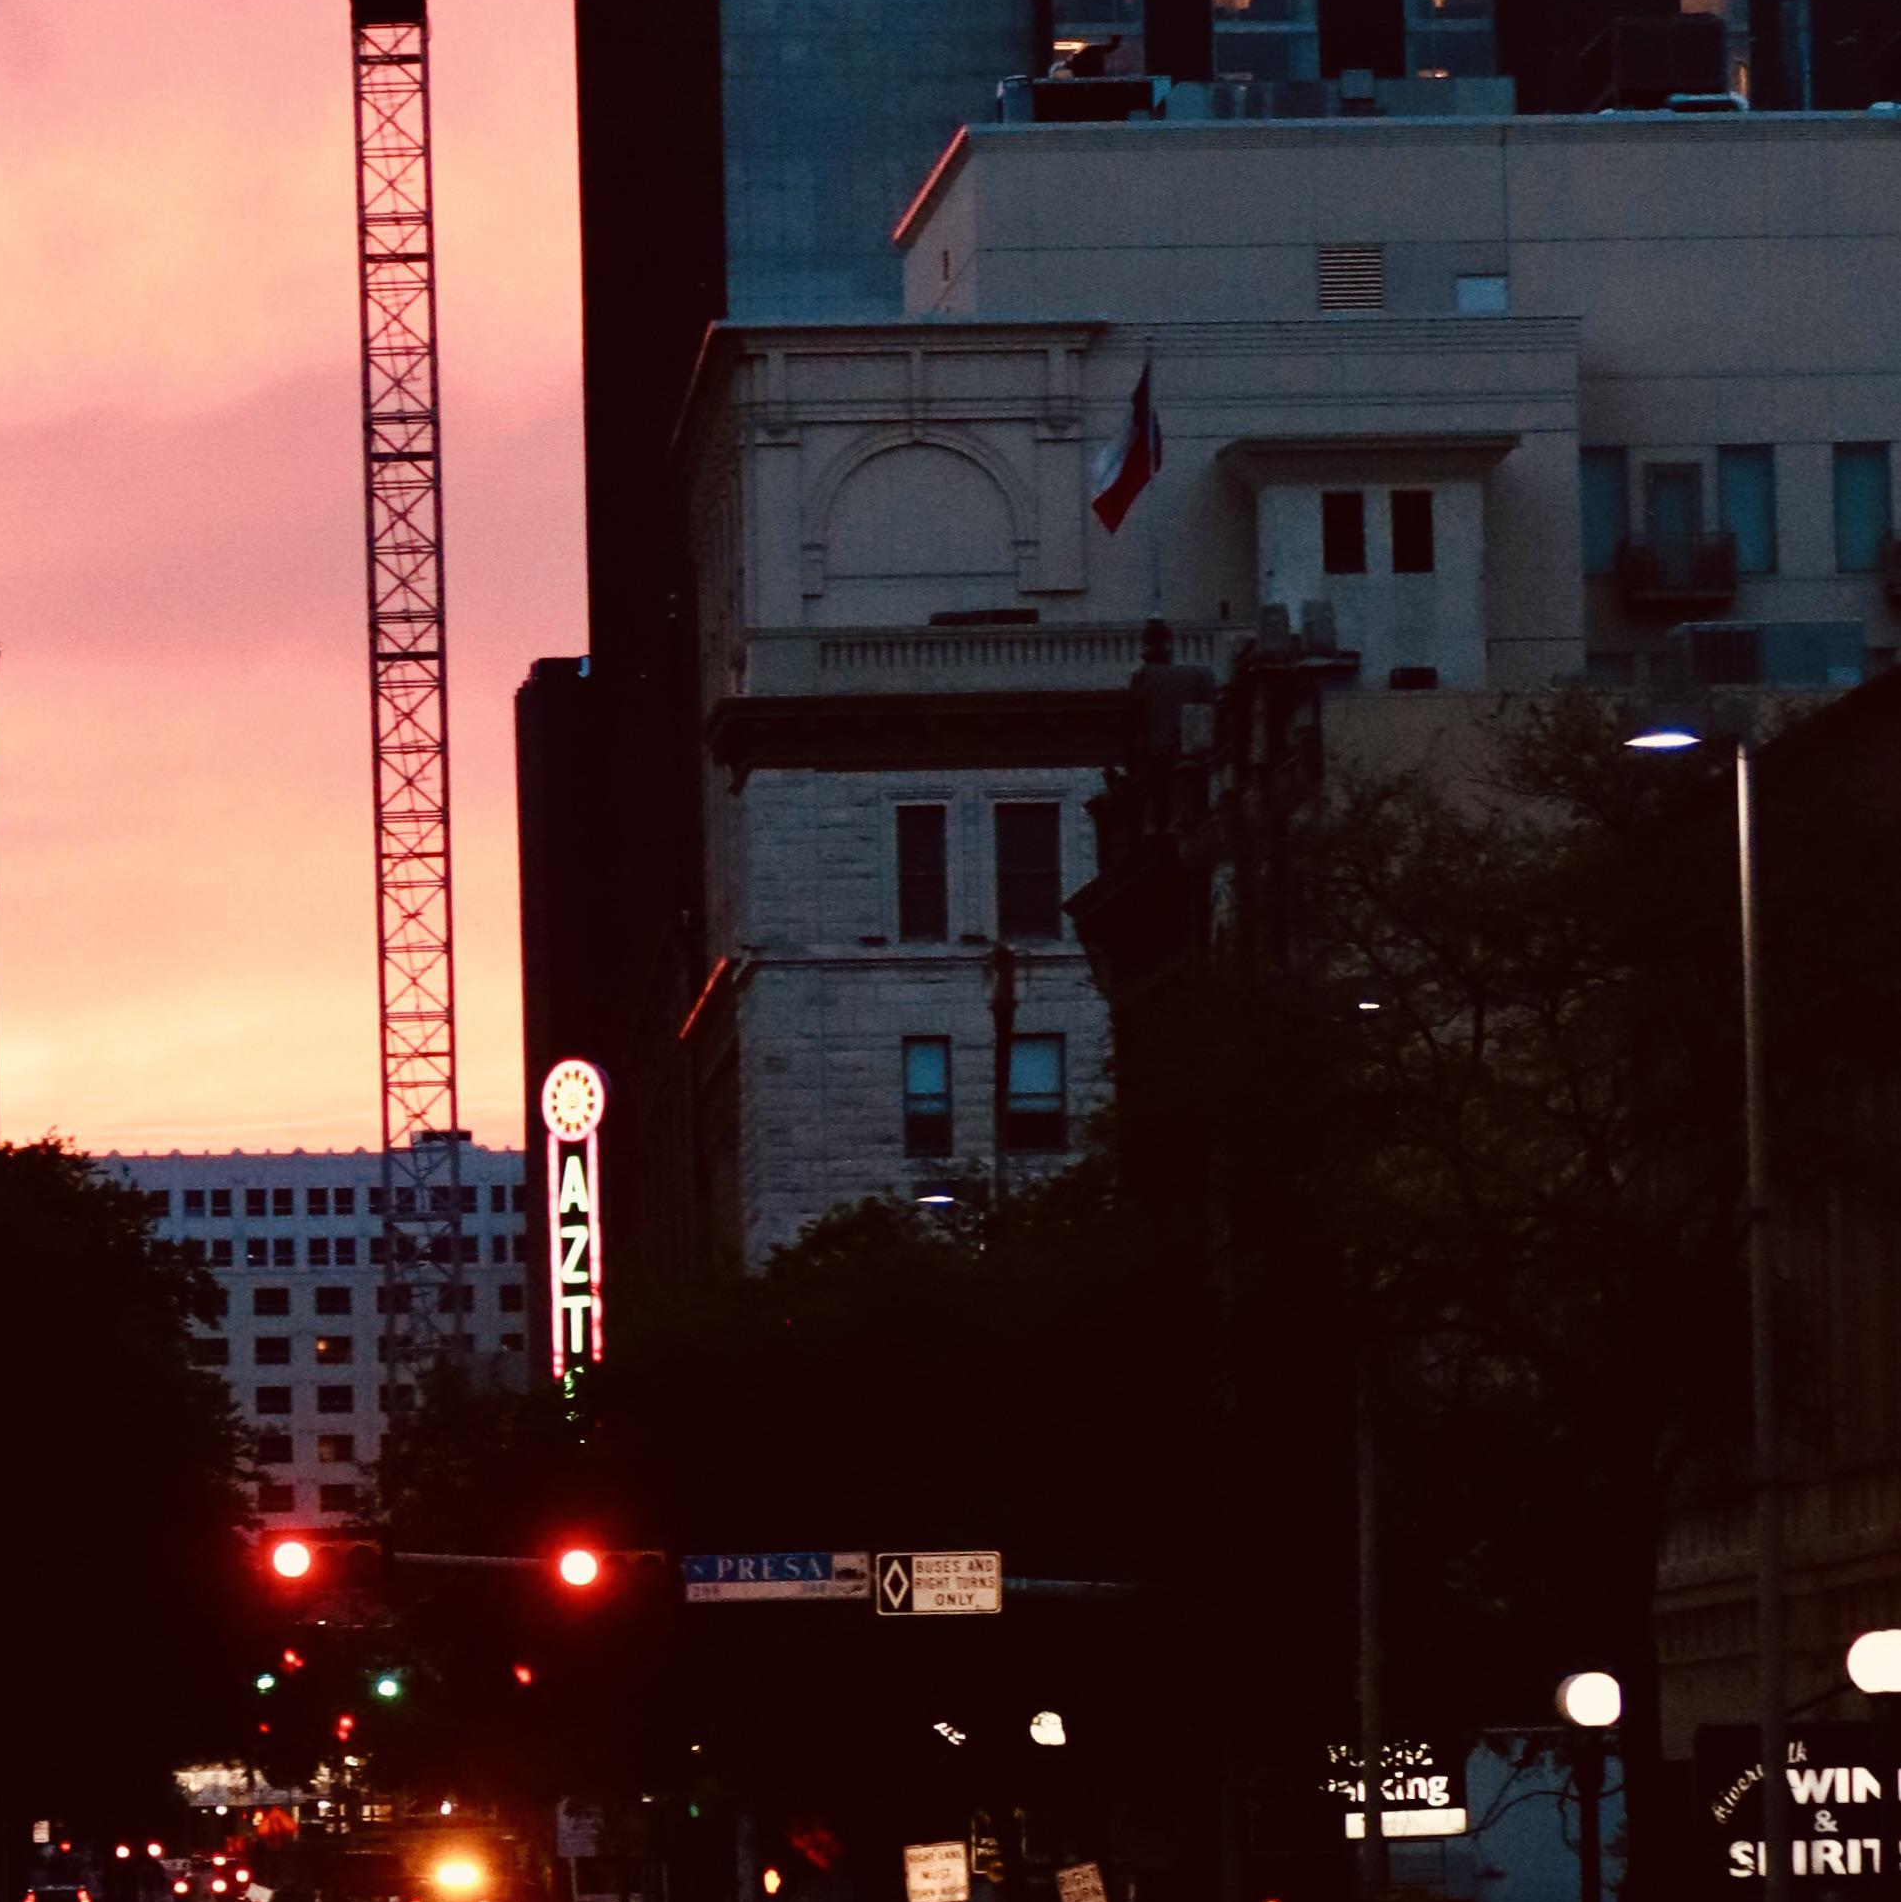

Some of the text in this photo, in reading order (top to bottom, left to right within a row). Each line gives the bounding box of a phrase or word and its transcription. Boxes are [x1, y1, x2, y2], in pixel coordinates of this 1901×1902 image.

[559, 1154, 593, 1399] AZT
[716, 1557, 824, 1580] PRESA
[934, 1593, 974, 1606] ONLY
[1785, 1766, 1901, 1805] WIN
[1814, 1810, 1839, 1833] &
[1728, 1837, 1901, 1878] SIRIT
